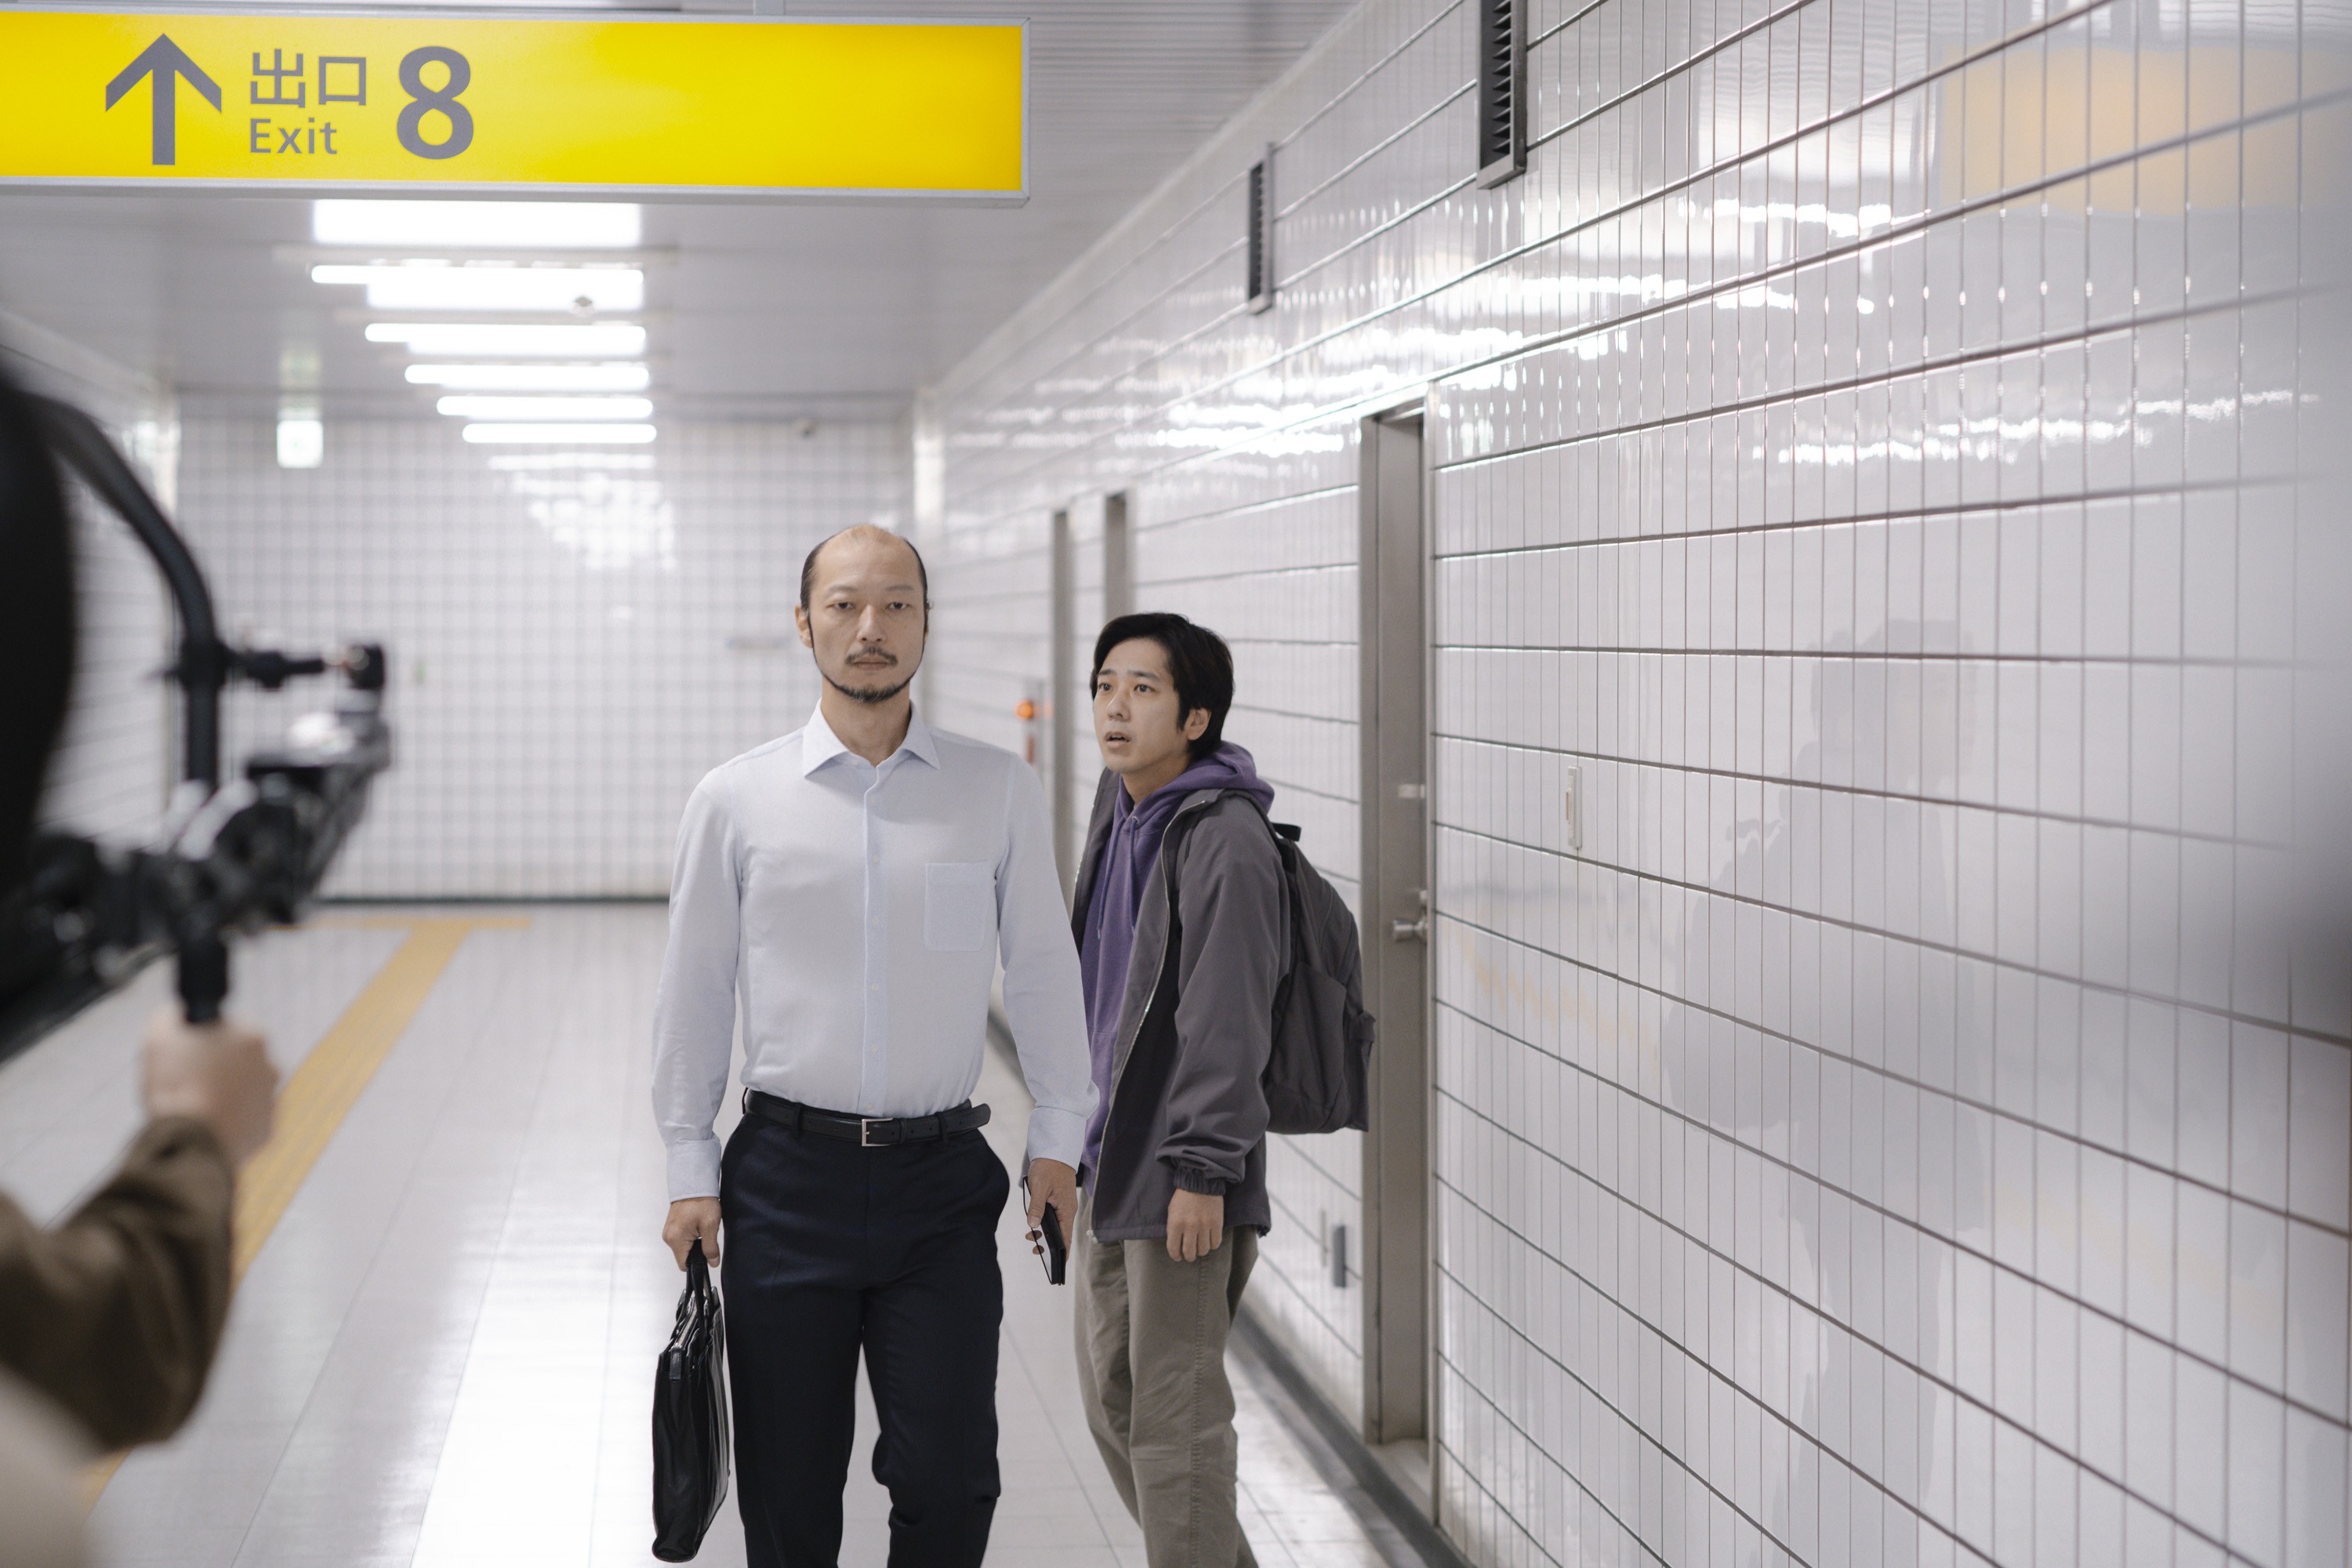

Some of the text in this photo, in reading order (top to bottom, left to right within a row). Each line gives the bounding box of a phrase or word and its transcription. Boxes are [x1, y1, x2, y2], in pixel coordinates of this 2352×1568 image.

[250, 48, 367, 108] 出口
[396, 45, 474, 160] 8
[250, 117, 338, 154] Exit
